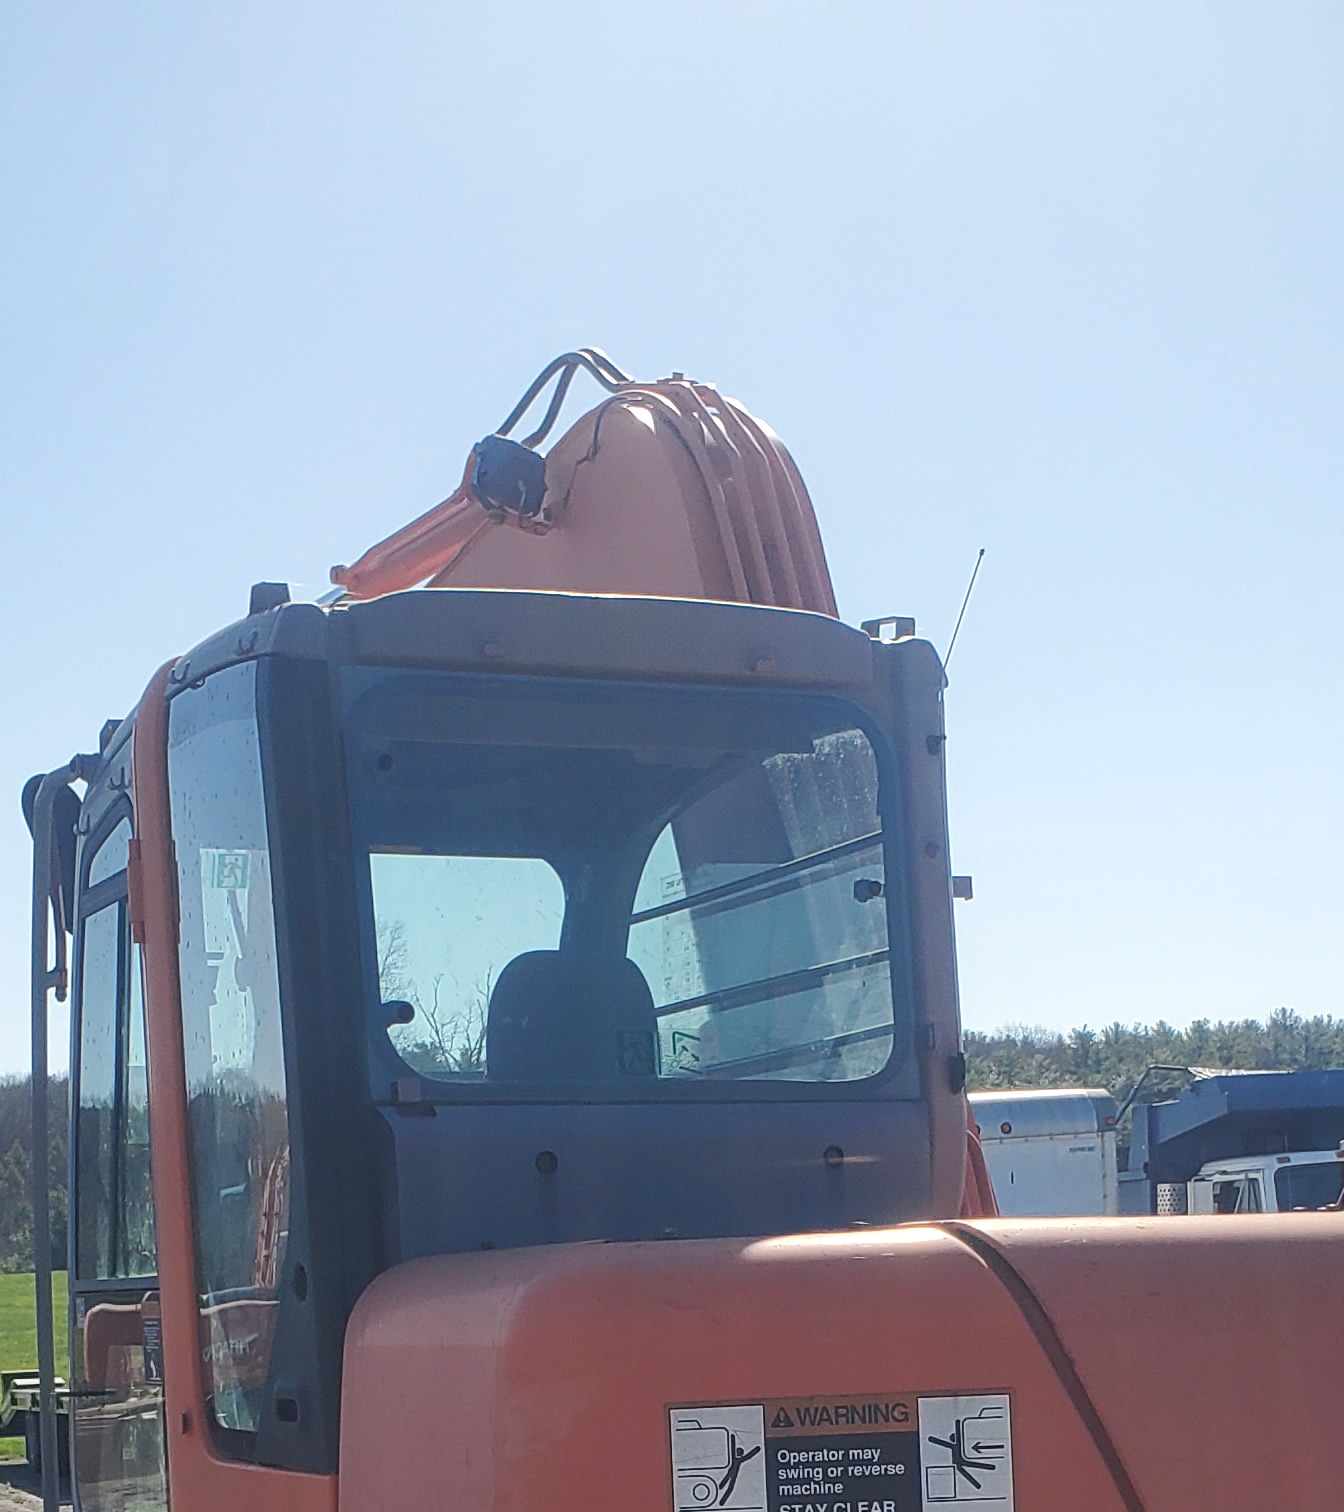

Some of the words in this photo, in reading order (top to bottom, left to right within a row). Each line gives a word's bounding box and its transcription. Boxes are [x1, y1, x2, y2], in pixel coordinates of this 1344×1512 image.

[796, 1402, 910, 1426] WARNING
[777, 1449, 845, 1466] Operator
[848, 1448, 881, 1462] may
[778, 1465, 823, 1481] swing
[827, 1466, 844, 1477] or
[848, 1463, 905, 1477] reverse
[778, 1481, 844, 1496] machine
